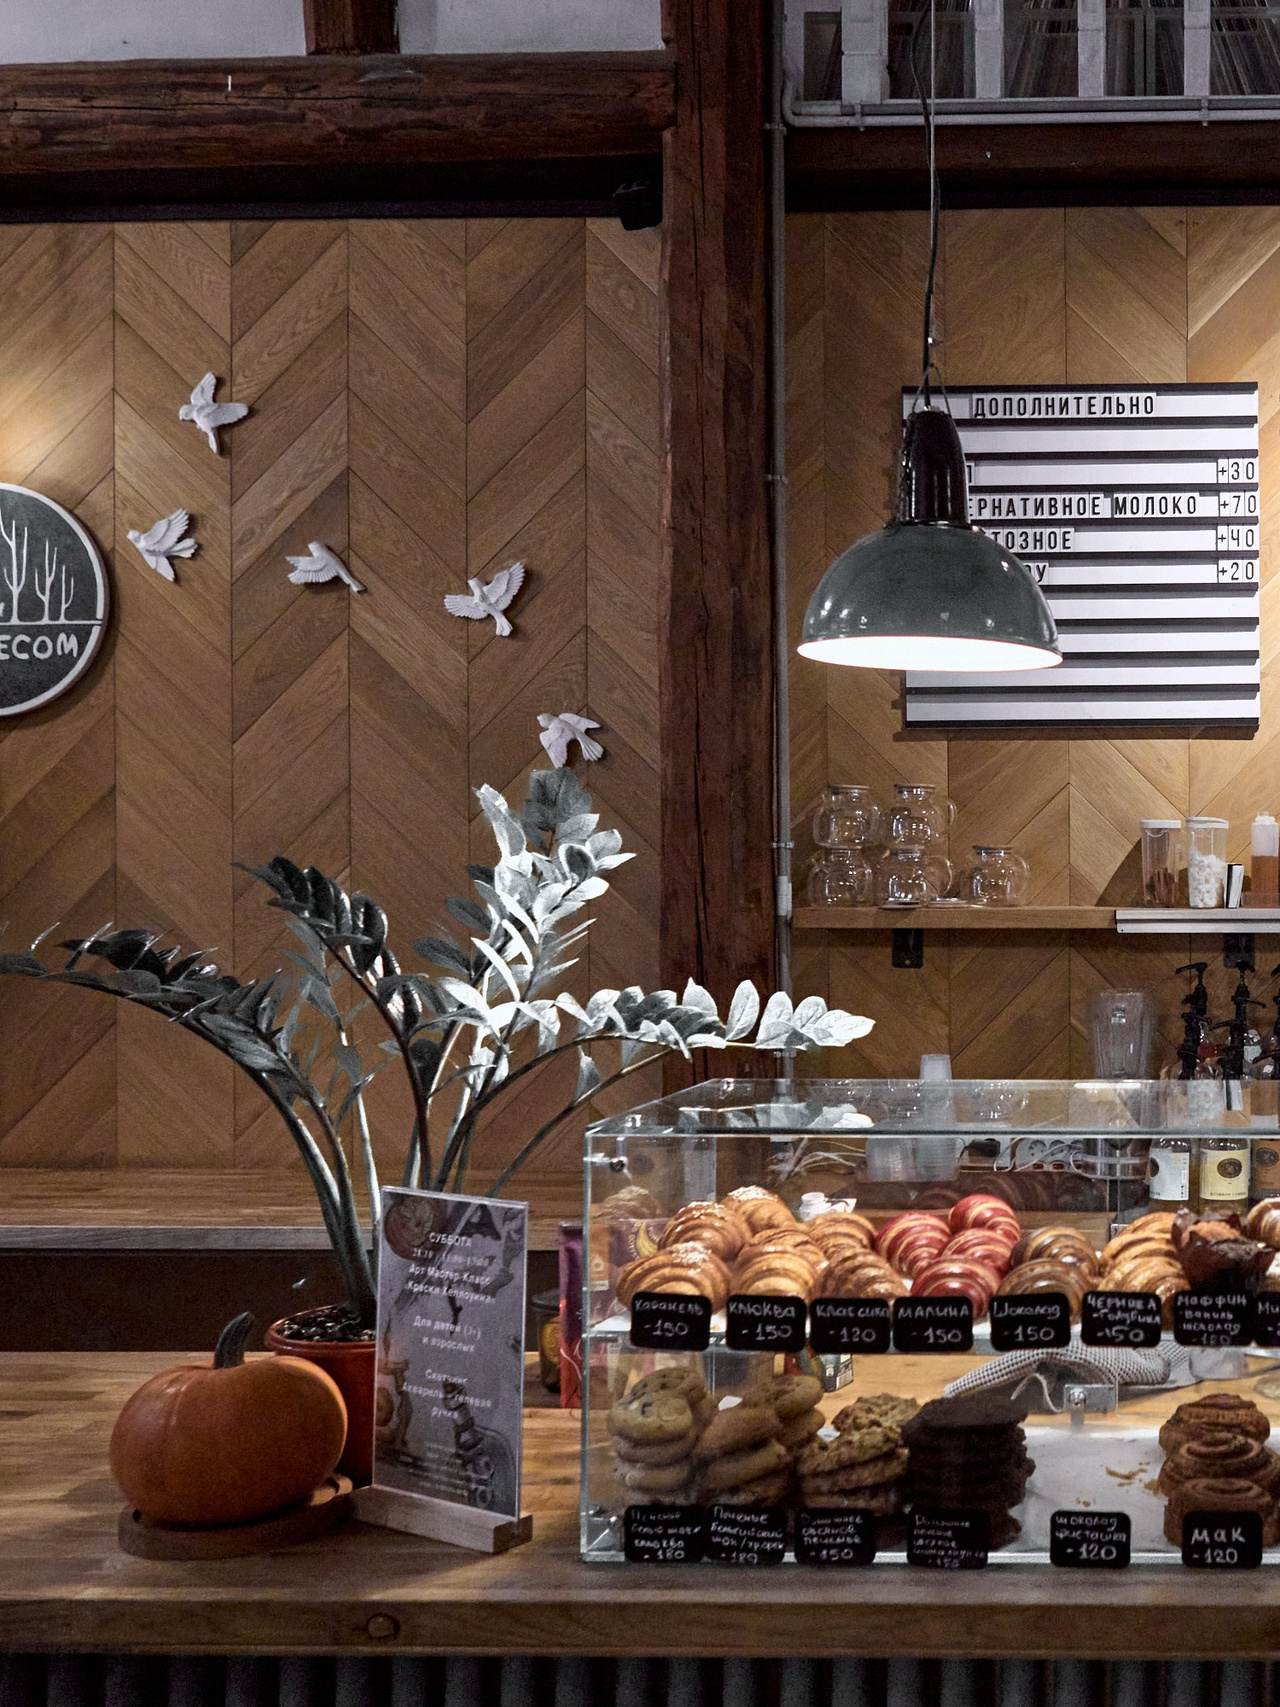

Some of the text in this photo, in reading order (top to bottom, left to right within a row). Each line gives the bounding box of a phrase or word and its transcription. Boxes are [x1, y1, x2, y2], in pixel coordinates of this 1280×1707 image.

[974, 396, 1155, 418] ДОПОЛНИТЕЛЬНО
[1218, 461, 1255, 480] +30
[969, 495, 1257, 516] РНАТИВНОЕ МОЛОКО +70
[991, 529, 1255, 550] ТОЗНОЕ +40
[1219, 562, 1255, 580] +20
[429, 1232, 472, 1247] СУББОТА
[409, 1263, 425, 1275] Арт
[413, 1316, 431, 1327] Для
